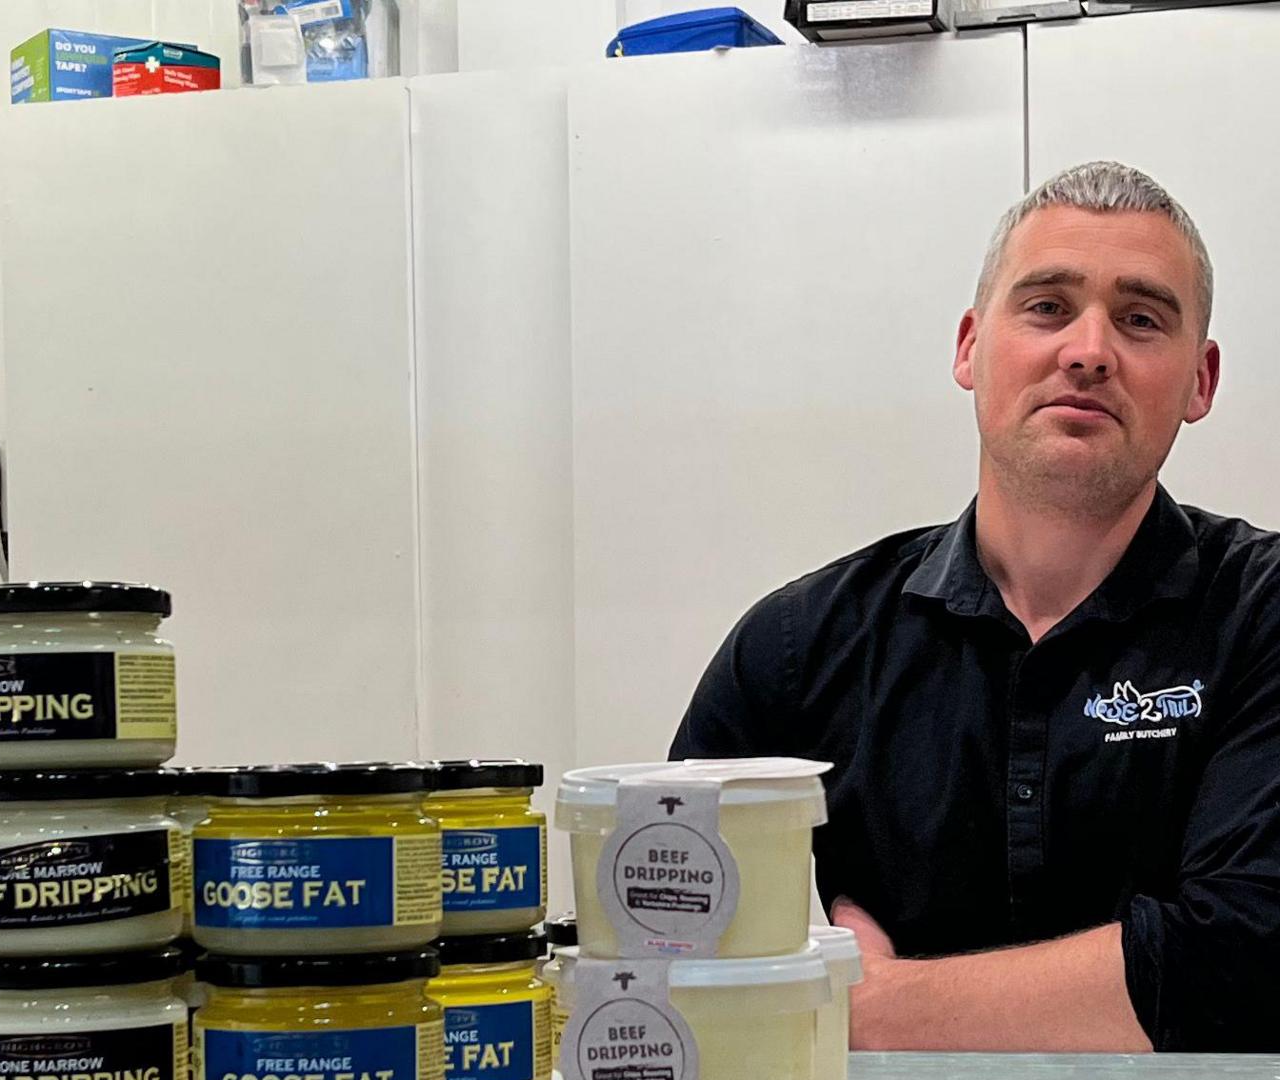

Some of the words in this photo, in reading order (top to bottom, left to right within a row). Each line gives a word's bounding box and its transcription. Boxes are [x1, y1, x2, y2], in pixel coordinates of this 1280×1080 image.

[55, 41, 71, 51] DO
[73, 43, 95, 54] YOU
[55, 61, 87, 72] TAPE?
[451, 853, 499, 866] RANGE
[648, 849, 689, 864] BEEF
[34, 862, 103, 879] MARROW
[230, 865, 265, 880] FREE
[268, 865, 320, 879] RANGE
[625, 866, 714, 885] DRIPPING
[442, 869, 476, 894] SE
[482, 865, 528, 893] FAT
[14, 870, 158, 910] DRIPPING
[203, 880, 295, 911] GOOSE
[303, 879, 366, 908] FAT
[608, 1026, 646, 1041] BEEF
[462, 1041, 515, 1070] FAT
[587, 1042, 673, 1060] DRIPPING
[33, 1057, 103, 1072] MARROW
[257, 1058, 294, 1072] FREE
[298, 1057, 352, 1071] RANGE
